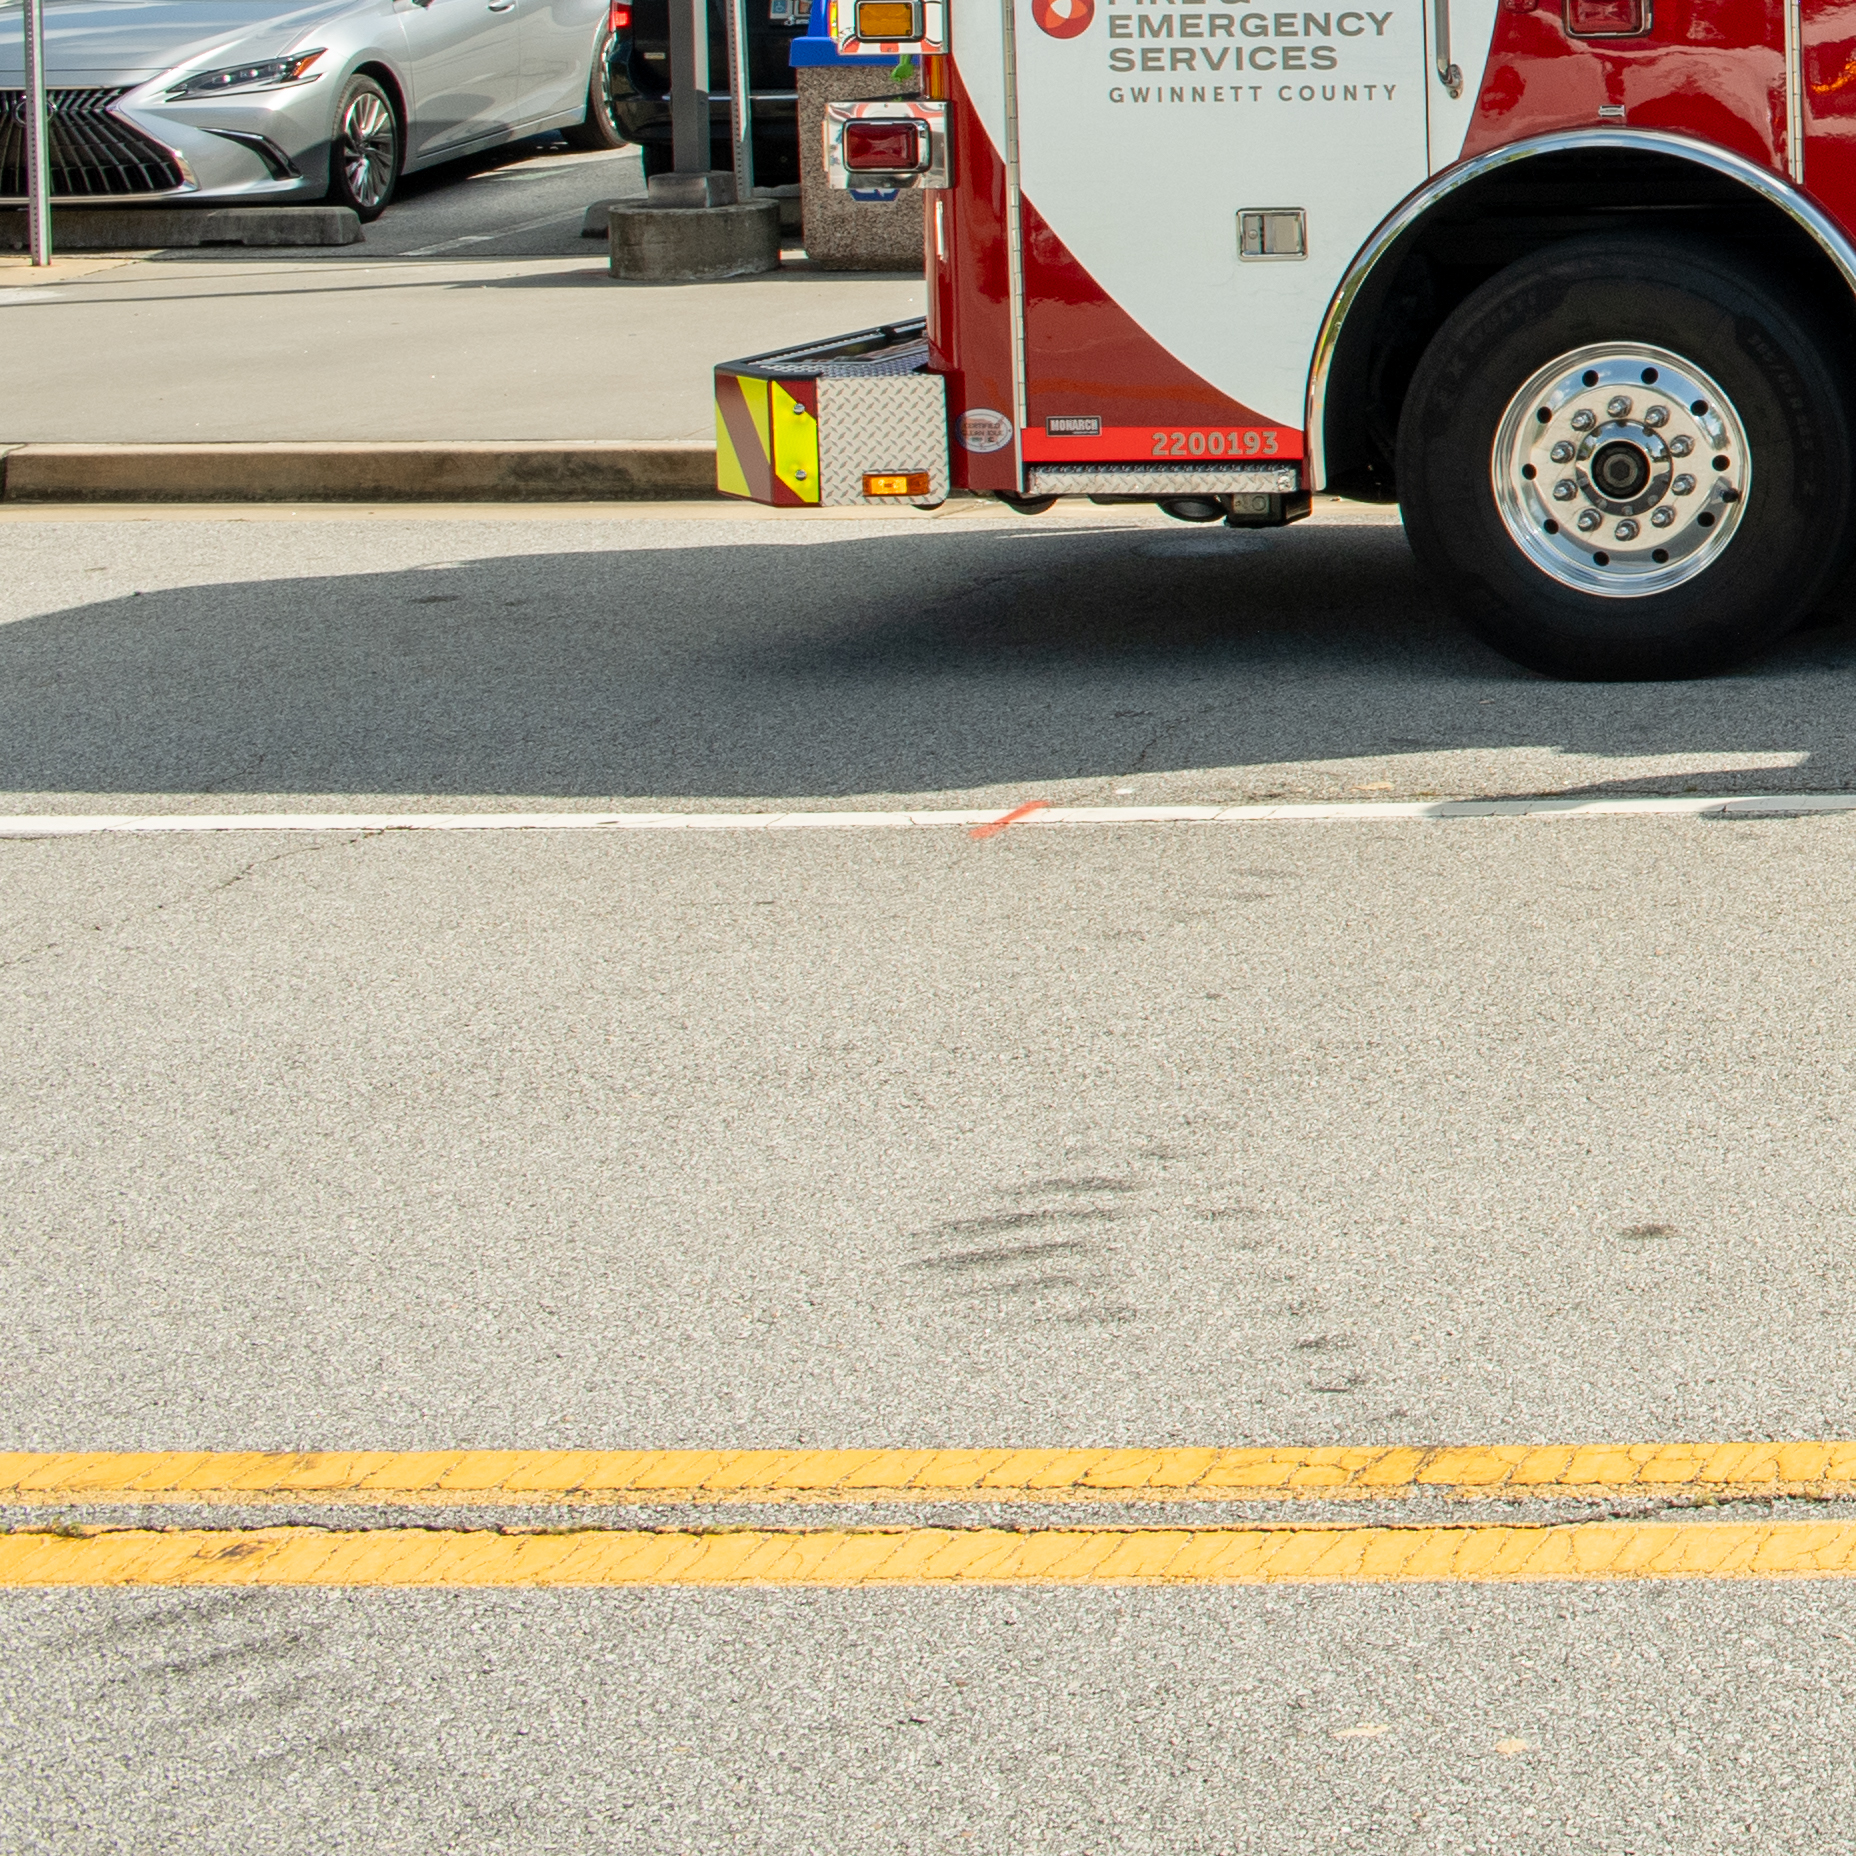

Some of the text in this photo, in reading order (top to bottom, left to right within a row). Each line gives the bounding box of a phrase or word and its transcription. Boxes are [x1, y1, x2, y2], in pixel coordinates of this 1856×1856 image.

[1108, 11, 1394, 39] EMERGENCY
[1108, 45, 1338, 72] SERVICES
[1108, 84, 1397, 103] GWINNETT COUNTY
[1050, 419, 1099, 431] MONARCH
[1151, 431, 1279, 456] 2200193
